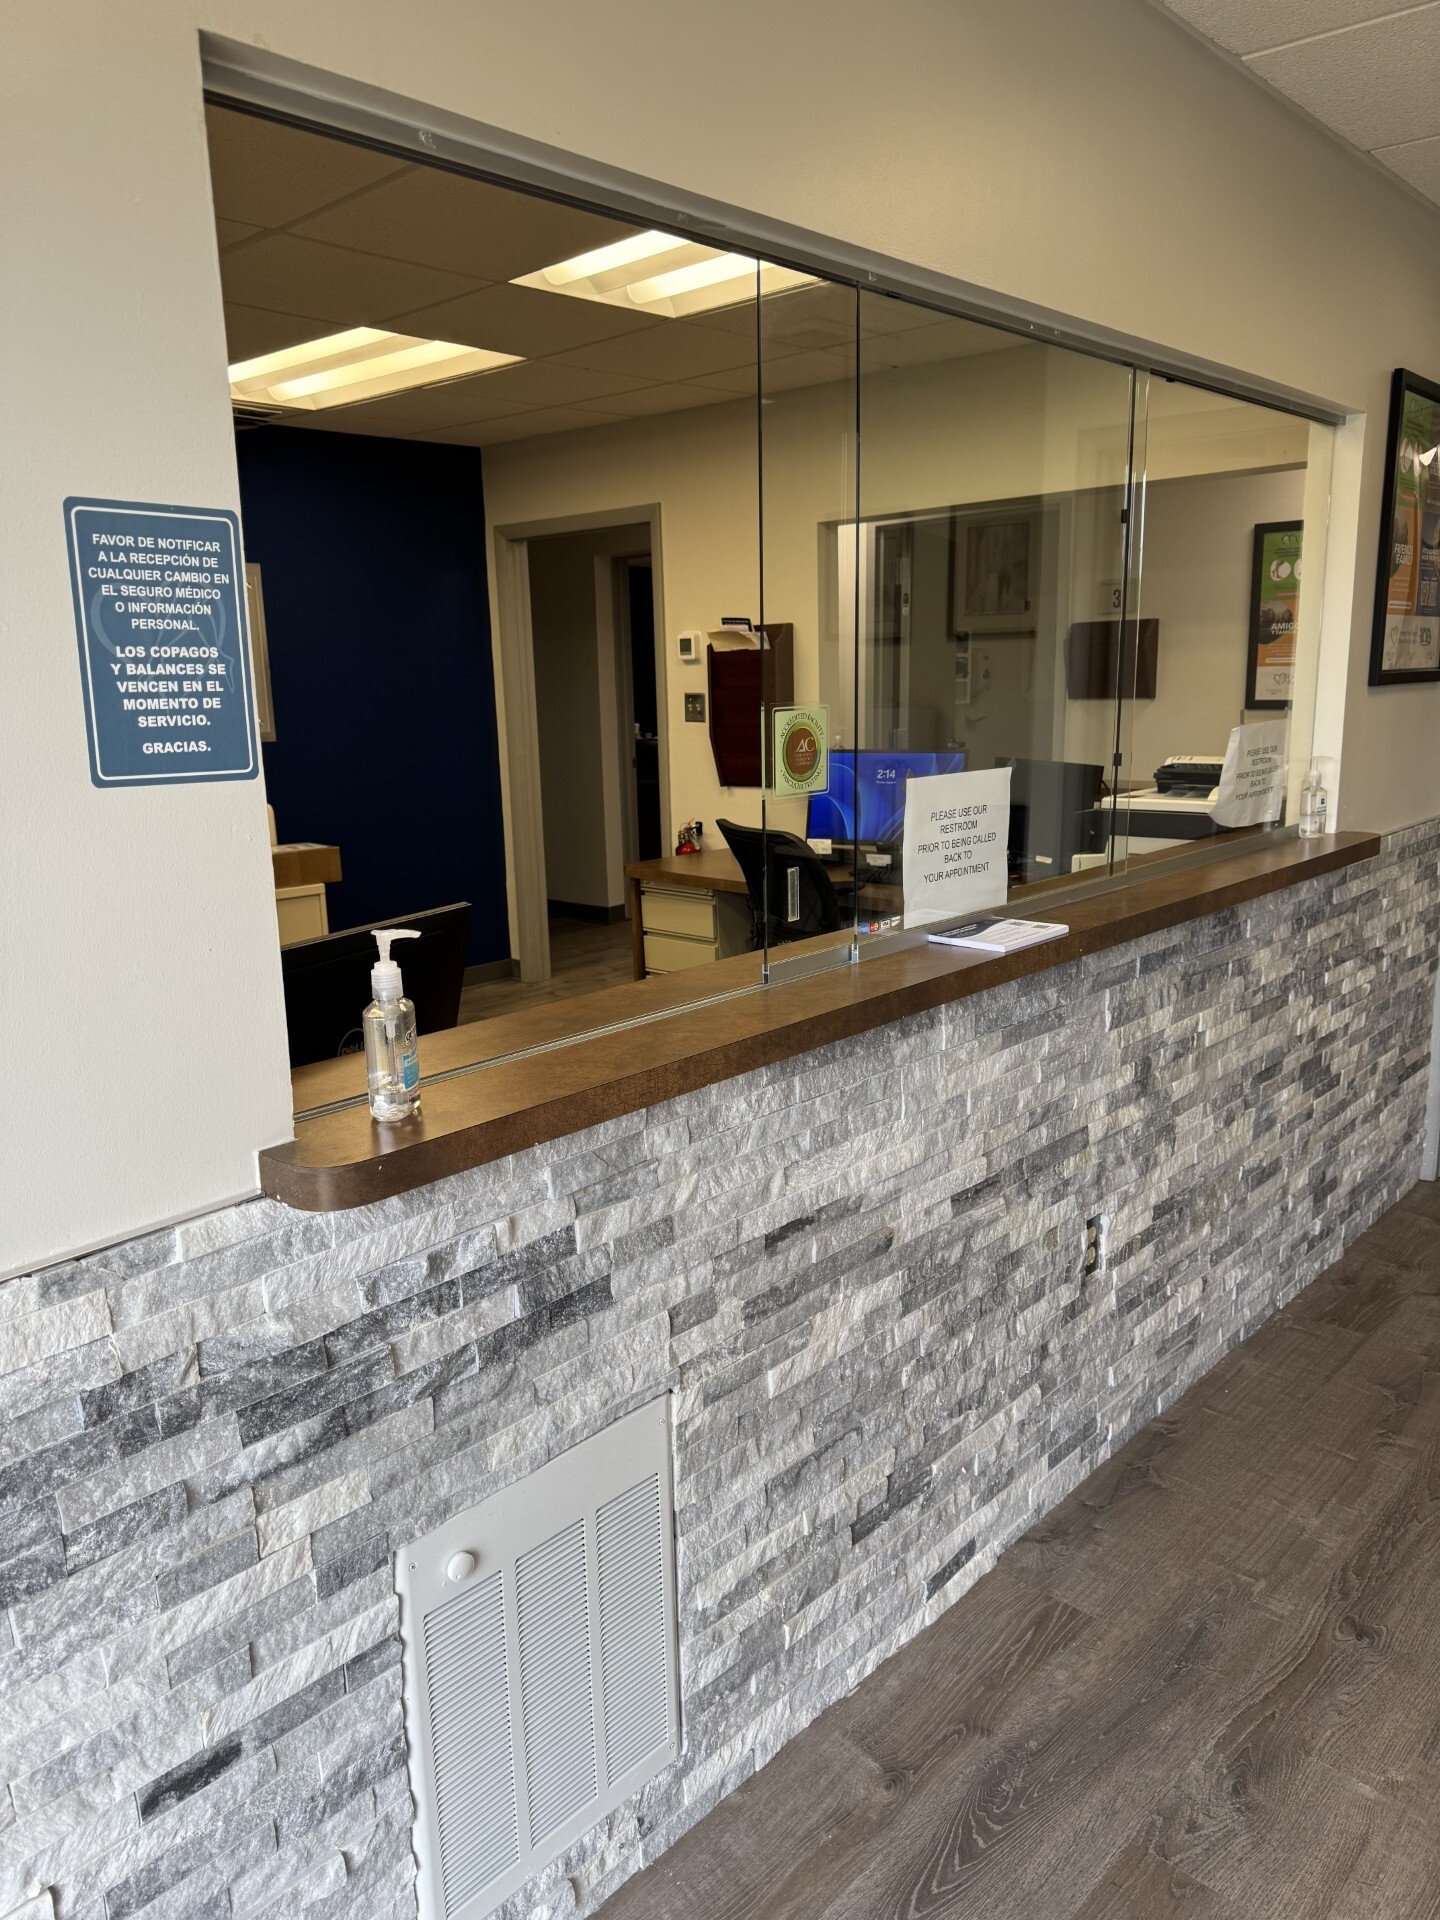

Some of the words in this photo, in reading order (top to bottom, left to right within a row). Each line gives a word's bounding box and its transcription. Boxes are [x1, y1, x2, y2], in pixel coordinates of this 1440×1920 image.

[93, 534, 135, 547] FAVOR
[138, 537, 155, 548] DE
[158, 538, 220, 552] NOTIFICAR
[98, 551, 107, 561] A
[110, 552, 127, 563] LA
[130, 552, 199, 567] RECEPCIÓN
[203, 557, 218, 568] DE
[88, 567, 161, 580] CUALQUIER
[165, 571, 210, 583] CAMBIO
[214, 574, 229, 584] EN
[102, 585, 118, 595] EL
[121, 585, 172, 597] SEGURO
[176, 586, 220, 599] MÉDICO
[115, 602, 124, 612] O
[128, 602, 211, 615] INFORMACIÓN
[132, 619, 199, 630] PERSONAL.
[116, 646, 145, 658] LOS
[150, 647, 218, 658] COPAGOS
[111, 664, 121, 675] Y
[126, 664, 204, 674] BALANCES
[208, 664, 226, 674] SE
[117, 682, 178, 692] VENCEN
[183, 681, 202, 691] EN
[206, 681, 223, 691] EL
[123, 698, 198, 710] MOMENTO
[203, 698, 221, 708] DE
[138, 715, 210, 727] SERVICIO.
[781, 713, 807, 739] ACCREDITED
[808, 714, 823, 736] FACILITY
[143, 741, 211, 754] GRACIAS.
[1247, 747, 1261, 757] PLEASE
[783, 771, 804, 789] VASCULAR
[804, 769, 821, 789] TESTING
[876, 769, 895, 779] 2:14
[1236, 771, 1250, 780] PRIOR
[931, 809, 956, 821] PLEASE
[958, 807, 972, 817] USE
[973, 805, 987, 815] OUR
[940, 820, 978, 834] RESTROOM
[918, 842, 939, 854] PRIOR
[941, 840, 950, 850] TO
[952, 837, 972, 848] BEING
[973, 832, 996, 844] CALLED
[945, 852, 962, 863] BACK
[964, 850, 972, 859] TO
[924, 872, 943, 883] YOUR
[945, 862, 989, 879] APPOINTMENT
